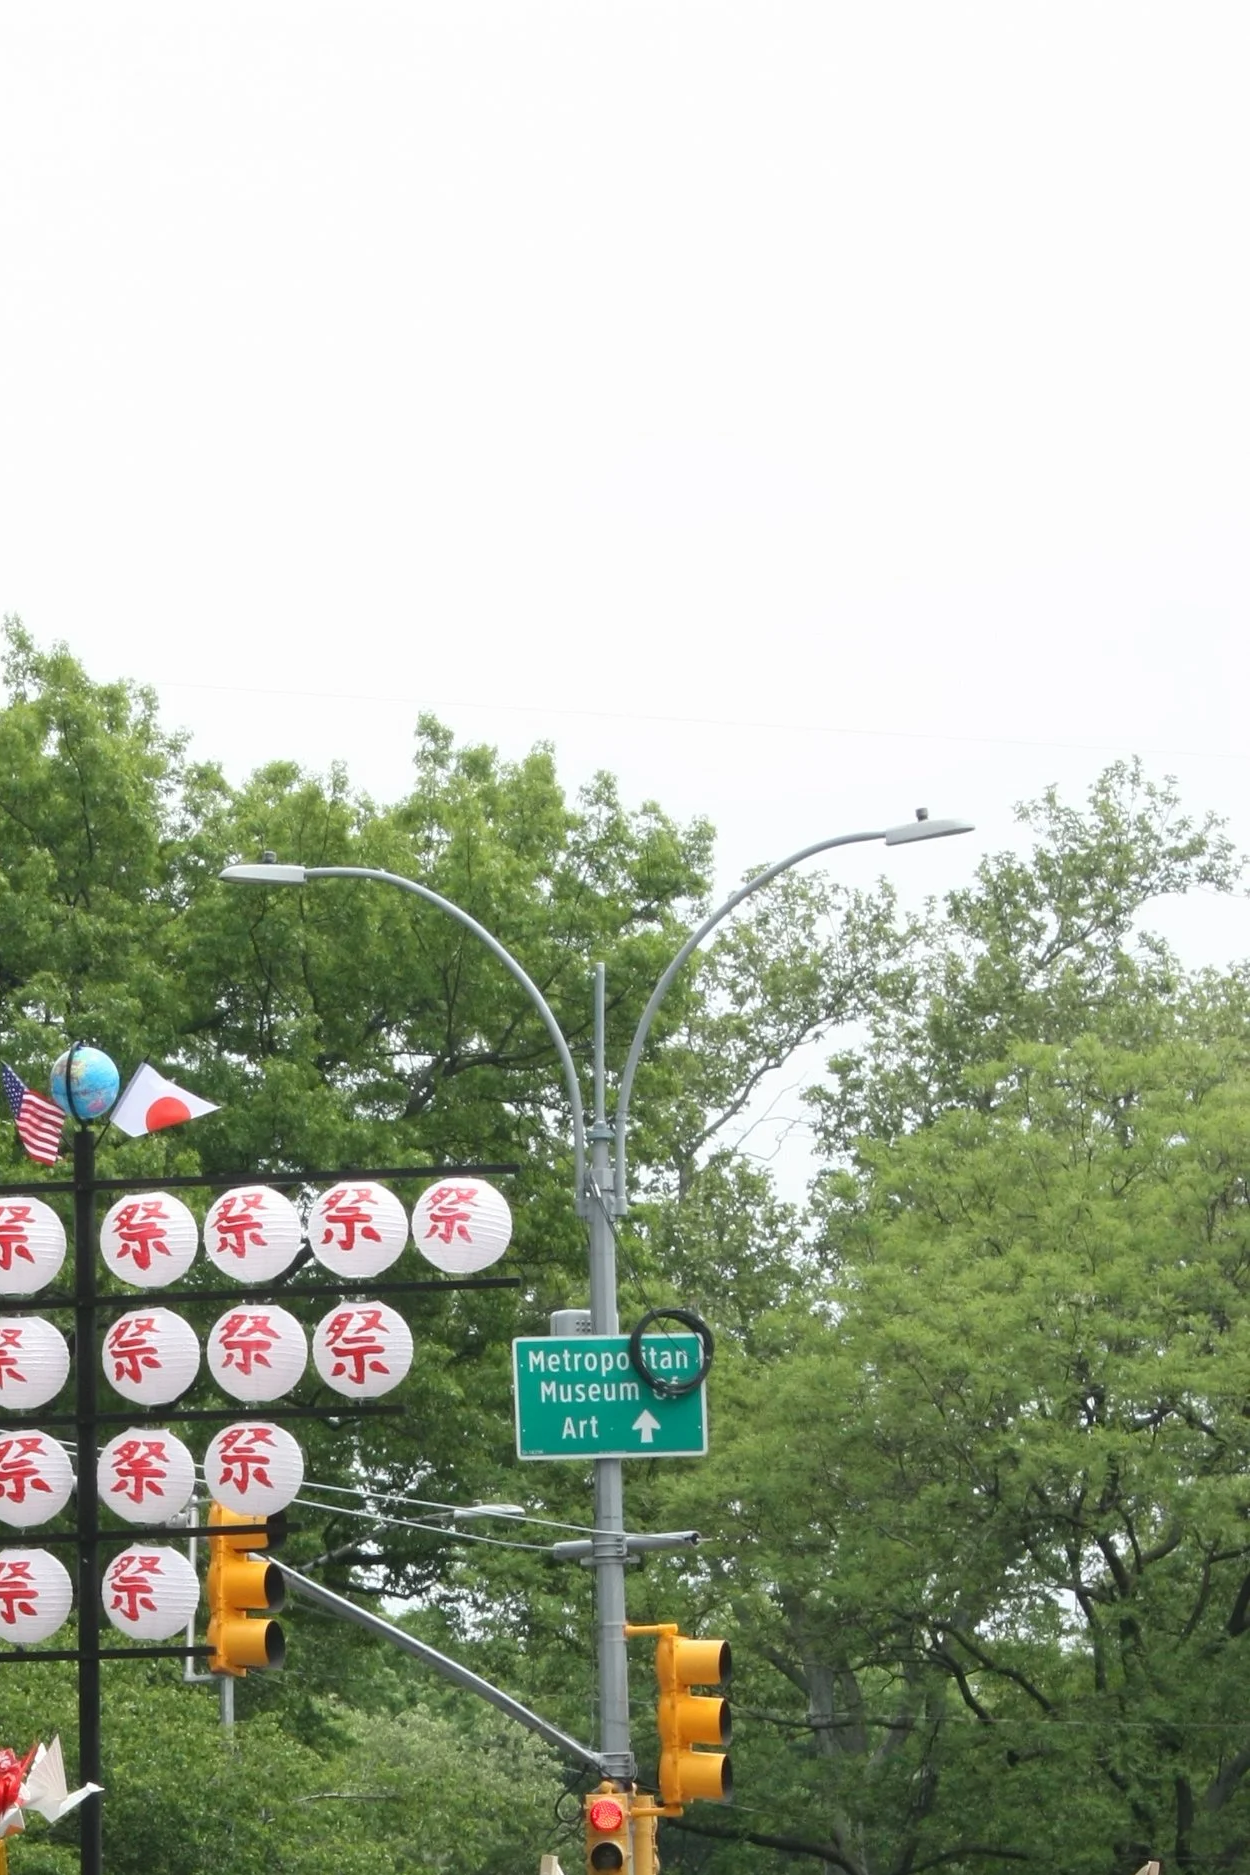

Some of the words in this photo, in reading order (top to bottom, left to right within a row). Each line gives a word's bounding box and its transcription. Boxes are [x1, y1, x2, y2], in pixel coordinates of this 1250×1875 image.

[115, 1200, 171, 1271] 祭
[213, 1193, 267, 1259] 祭
[322, 1188, 383, 1252] 祭
[426, 1187, 477, 1244] 祭
[109, 1316, 162, 1384] 祭
[219, 1313, 279, 1376] 祭
[325, 1309, 390, 1385] 祭
[528, 1346, 689, 1377] Metropoitan
[540, 1380, 640, 1403] Museum
[561, 1415, 599, 1440] Art
[110, 1439, 168, 1504] 祭
[217, 1426, 278, 1495] 祭
[110, 1554, 161, 1622] 祭
